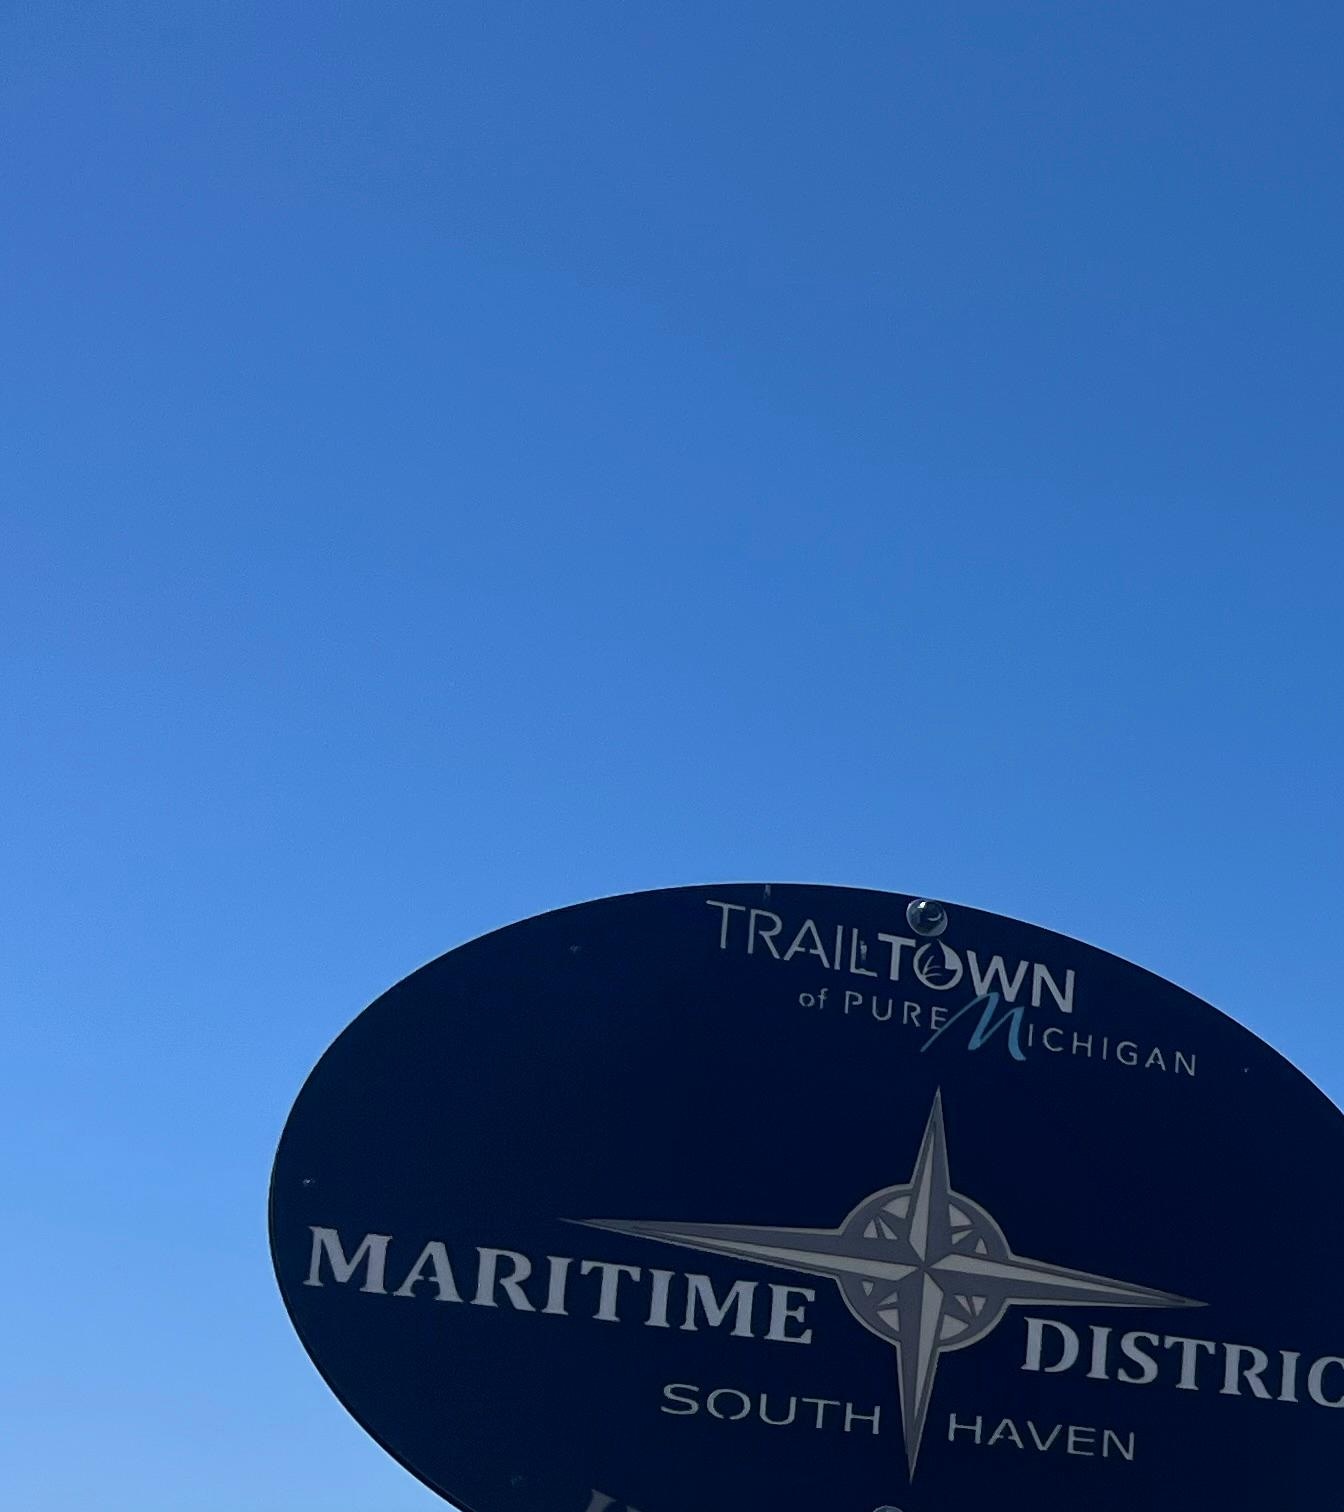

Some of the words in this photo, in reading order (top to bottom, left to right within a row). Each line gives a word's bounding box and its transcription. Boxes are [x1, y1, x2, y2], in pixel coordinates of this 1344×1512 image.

[706, 900, 1076, 1013] TRAILTOWN
[799, 987, 829, 1010] of
[844, 990, 949, 1031] PURE
[920, 991, 1197, 1077] MICHIGAN
[303, 1226, 817, 1345] MARITIME
[660, 1383, 882, 1435] SOUTH
[947, 1412, 1136, 1461] HAVEN
